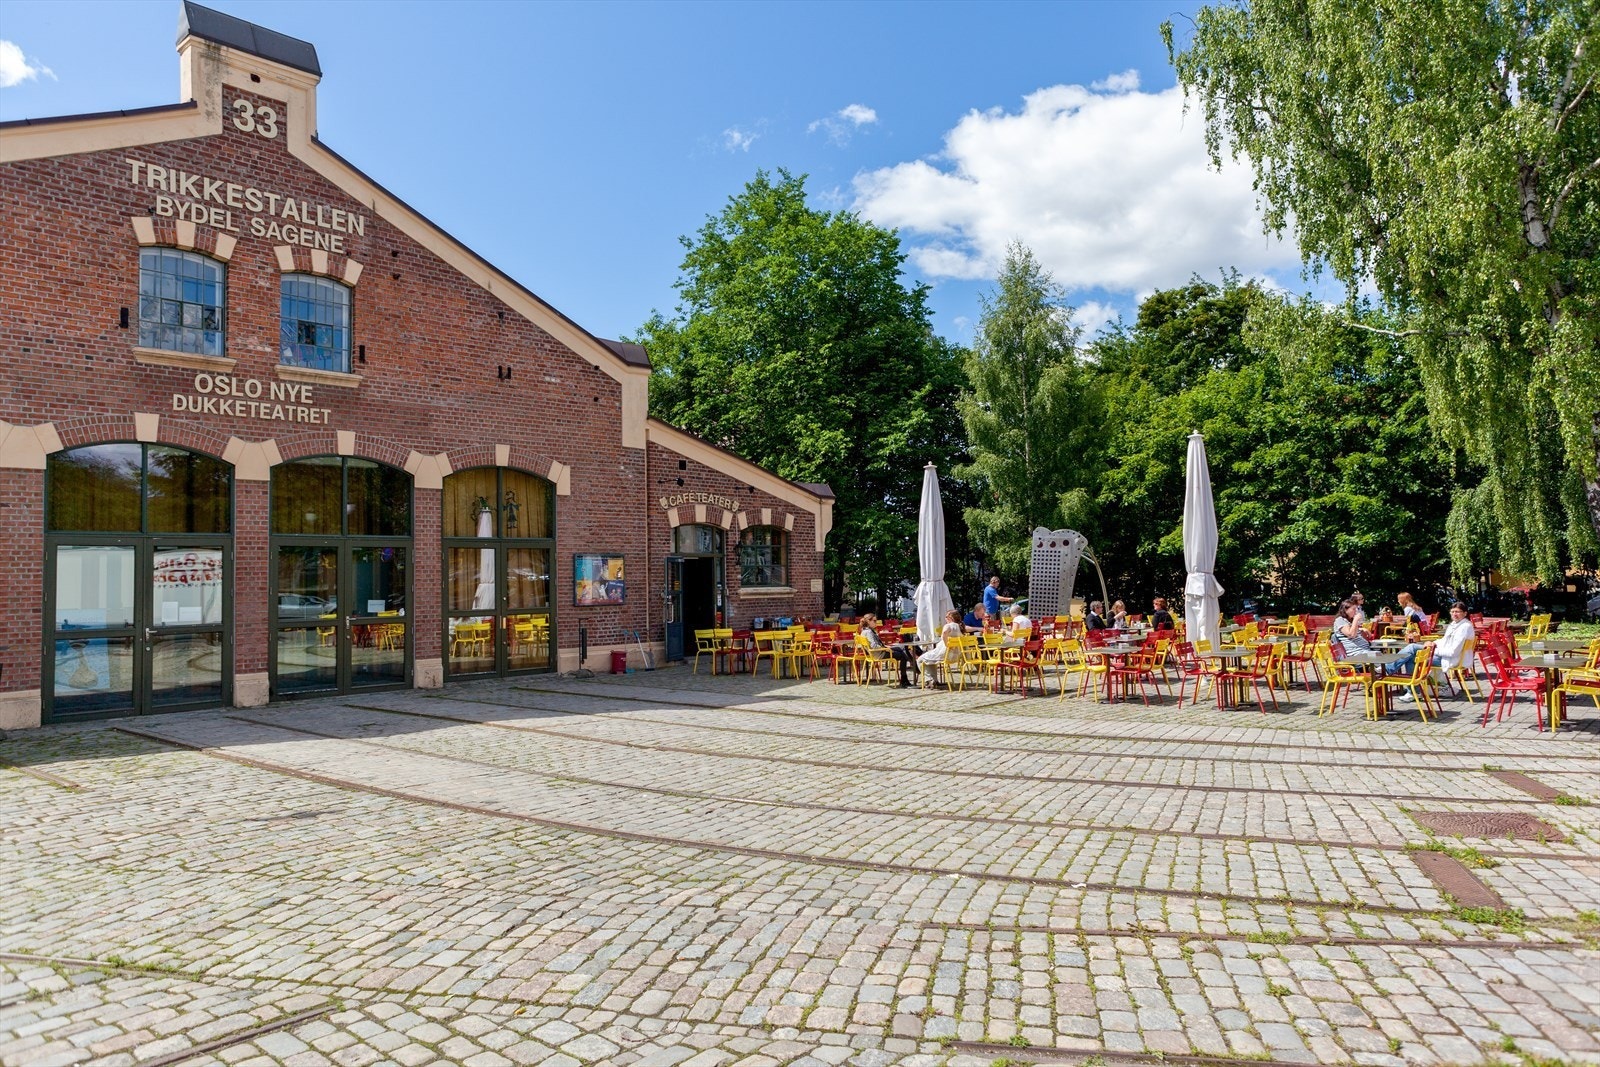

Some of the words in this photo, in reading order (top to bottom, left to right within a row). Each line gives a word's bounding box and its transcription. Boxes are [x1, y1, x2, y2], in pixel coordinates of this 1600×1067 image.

[232, 99, 278, 139] 33
[125, 158, 365, 237] TRIKKESTALLEN
[155, 195, 240, 232] BYDEL
[250, 217, 344, 254] SAGENE
[194, 373, 262, 398] OSLO
[270, 382, 313, 404] NYE
[173, 394, 331, 425] DUKKETEATRET
